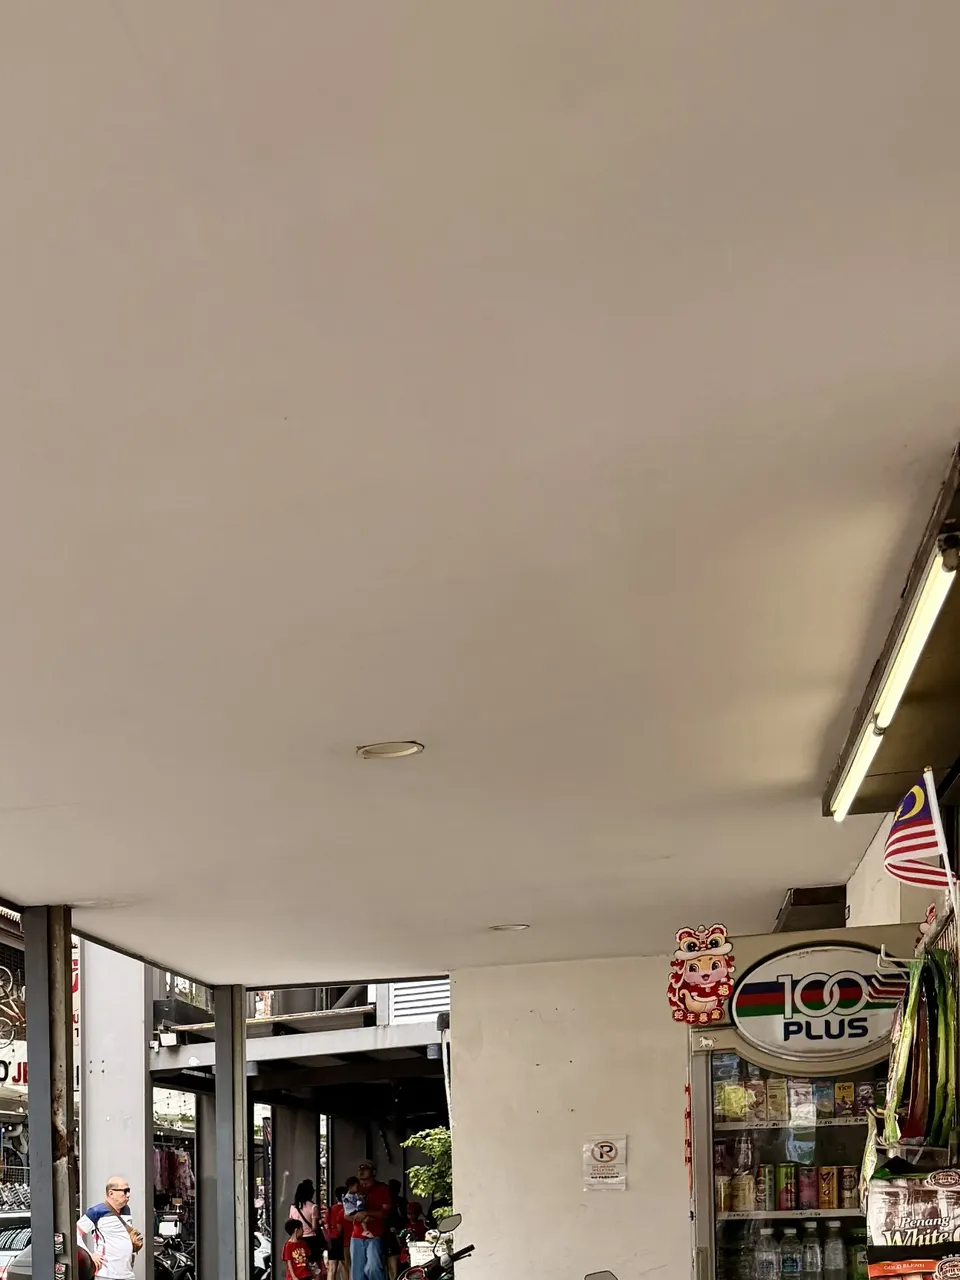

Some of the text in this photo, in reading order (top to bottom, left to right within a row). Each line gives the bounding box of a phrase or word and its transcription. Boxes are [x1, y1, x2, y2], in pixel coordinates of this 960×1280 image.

[777, 970, 869, 1019] 100
[783, 1017, 869, 1041] PLUS
[901, 1216, 951, 1231] Penang
[883, 1228, 950, 1247] White
